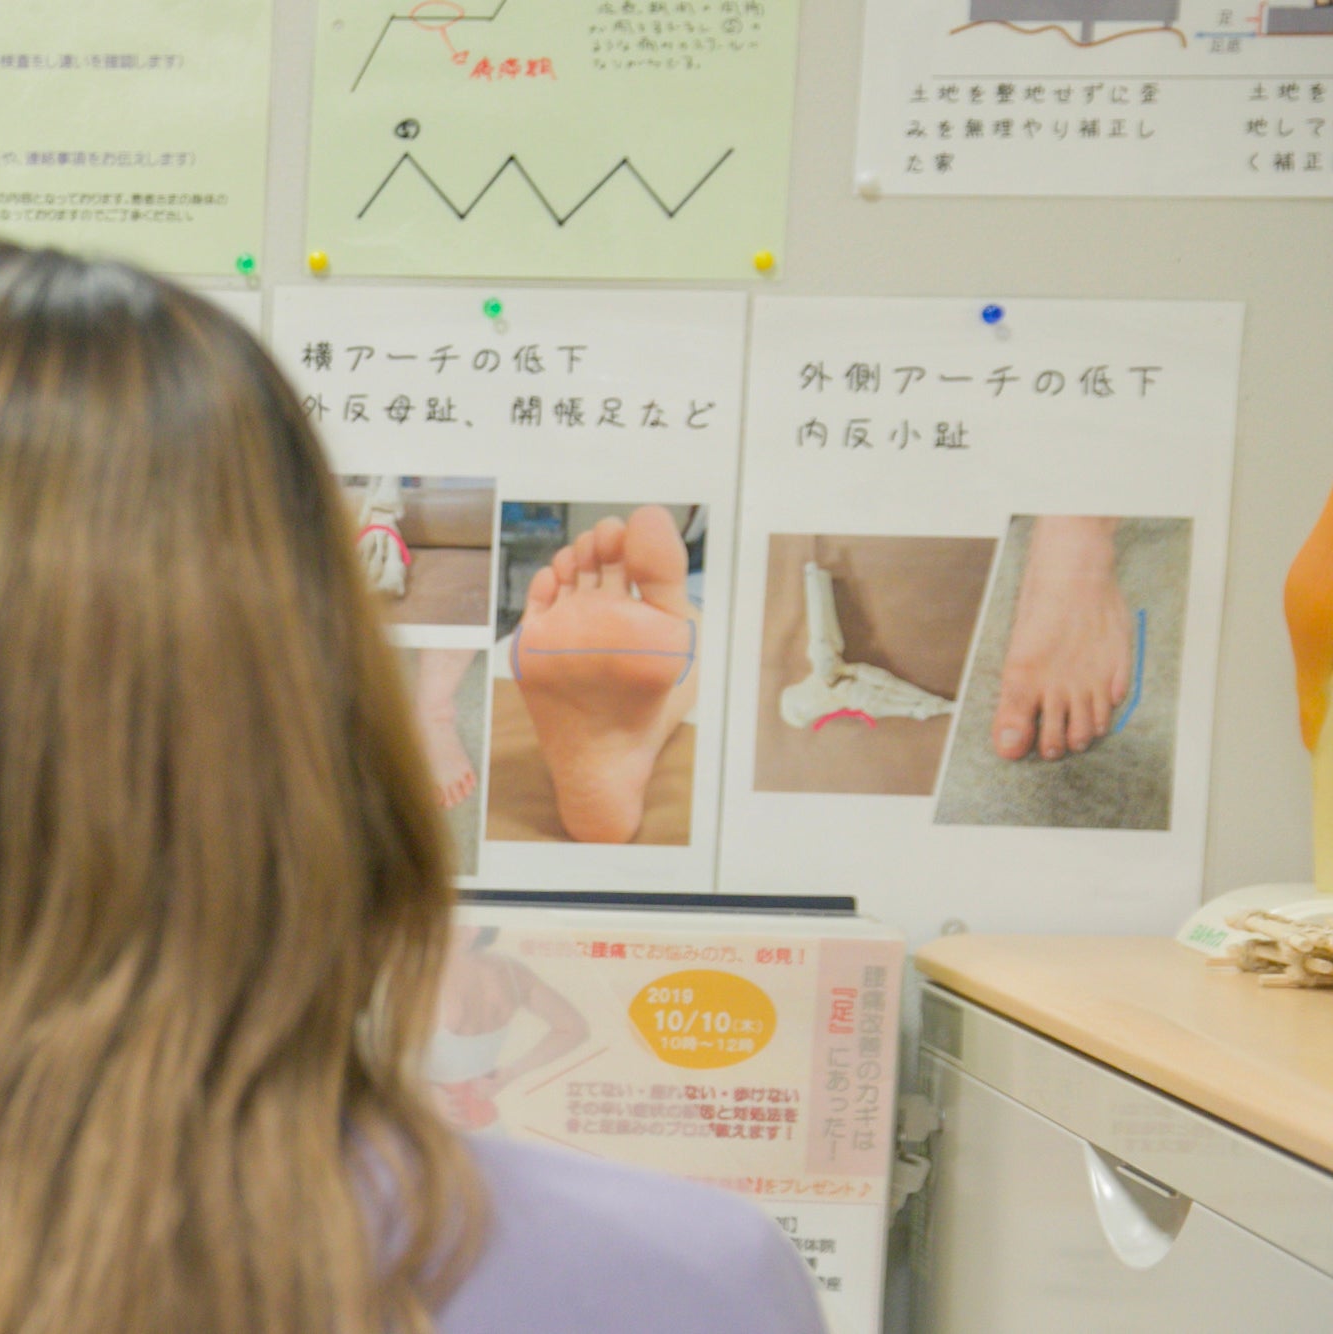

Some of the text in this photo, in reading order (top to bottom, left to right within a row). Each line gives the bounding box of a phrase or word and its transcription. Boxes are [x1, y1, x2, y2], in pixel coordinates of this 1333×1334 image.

[906, 118, 1156, 140] みを無理やり補正し
[905, 152, 955, 174] た家
[302, 342, 589, 374] 横アーチの低下
[800, 362, 1163, 397] 外側アーチの低下
[797, 417, 970, 450] 内反小趾
[646, 987, 694, 1004] 2019
